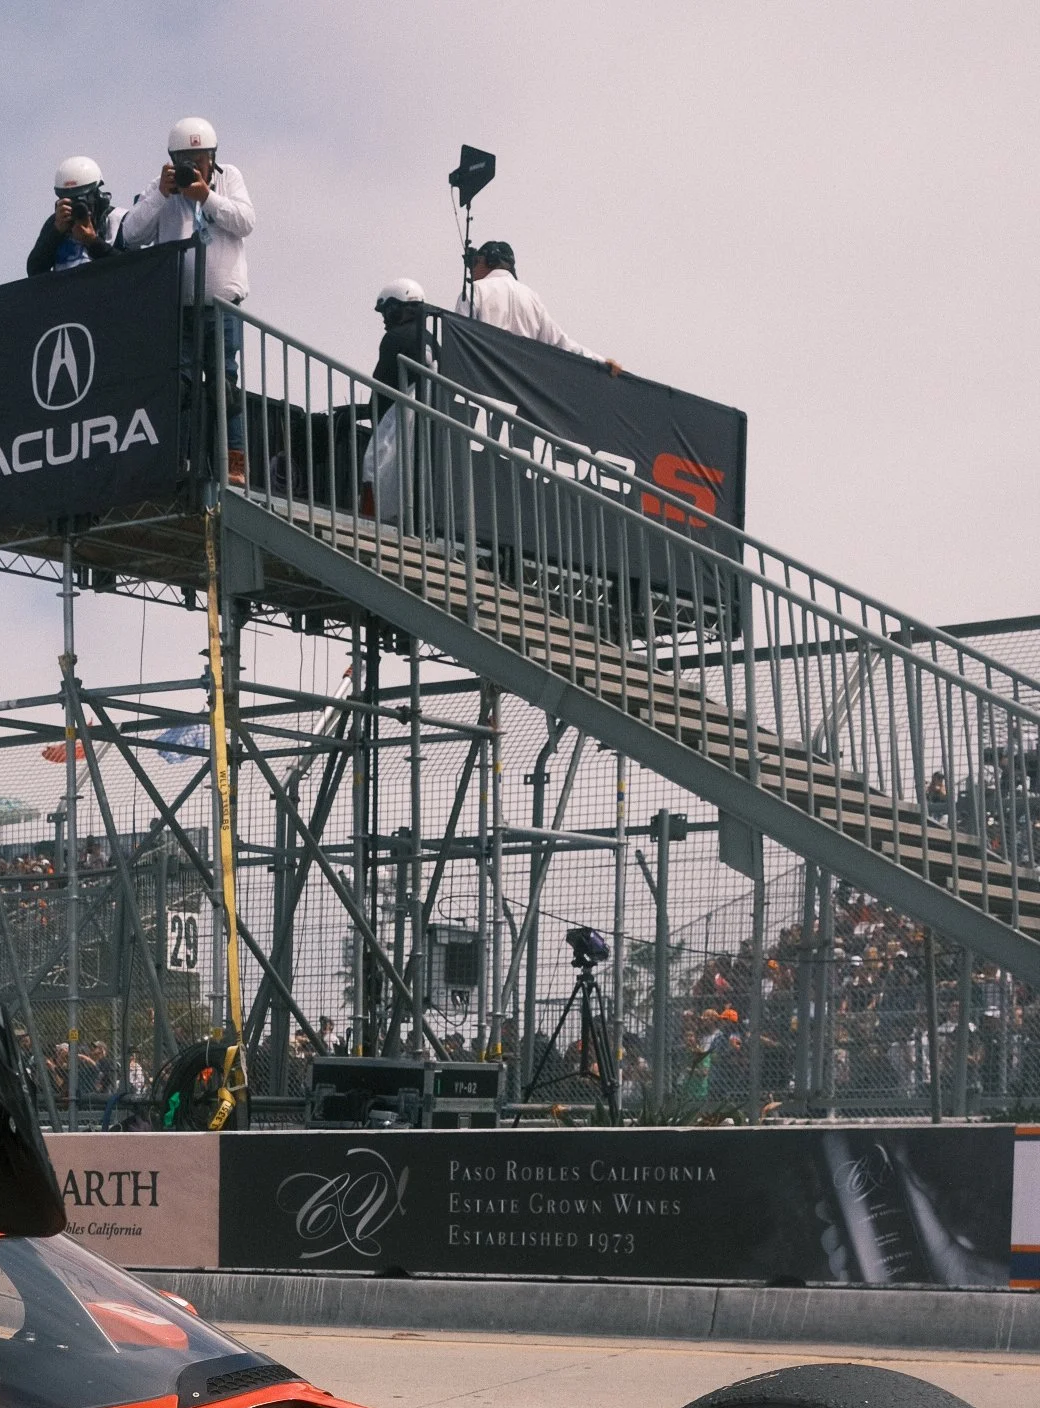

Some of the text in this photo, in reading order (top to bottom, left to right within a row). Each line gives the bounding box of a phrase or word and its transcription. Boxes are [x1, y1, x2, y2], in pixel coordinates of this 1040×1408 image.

[170, 915, 199, 970] 29
[61, 1168, 160, 1207] ARTH
[63, 1222, 142, 1240] bles California
[589, 1233, 635, 1254] 1973
